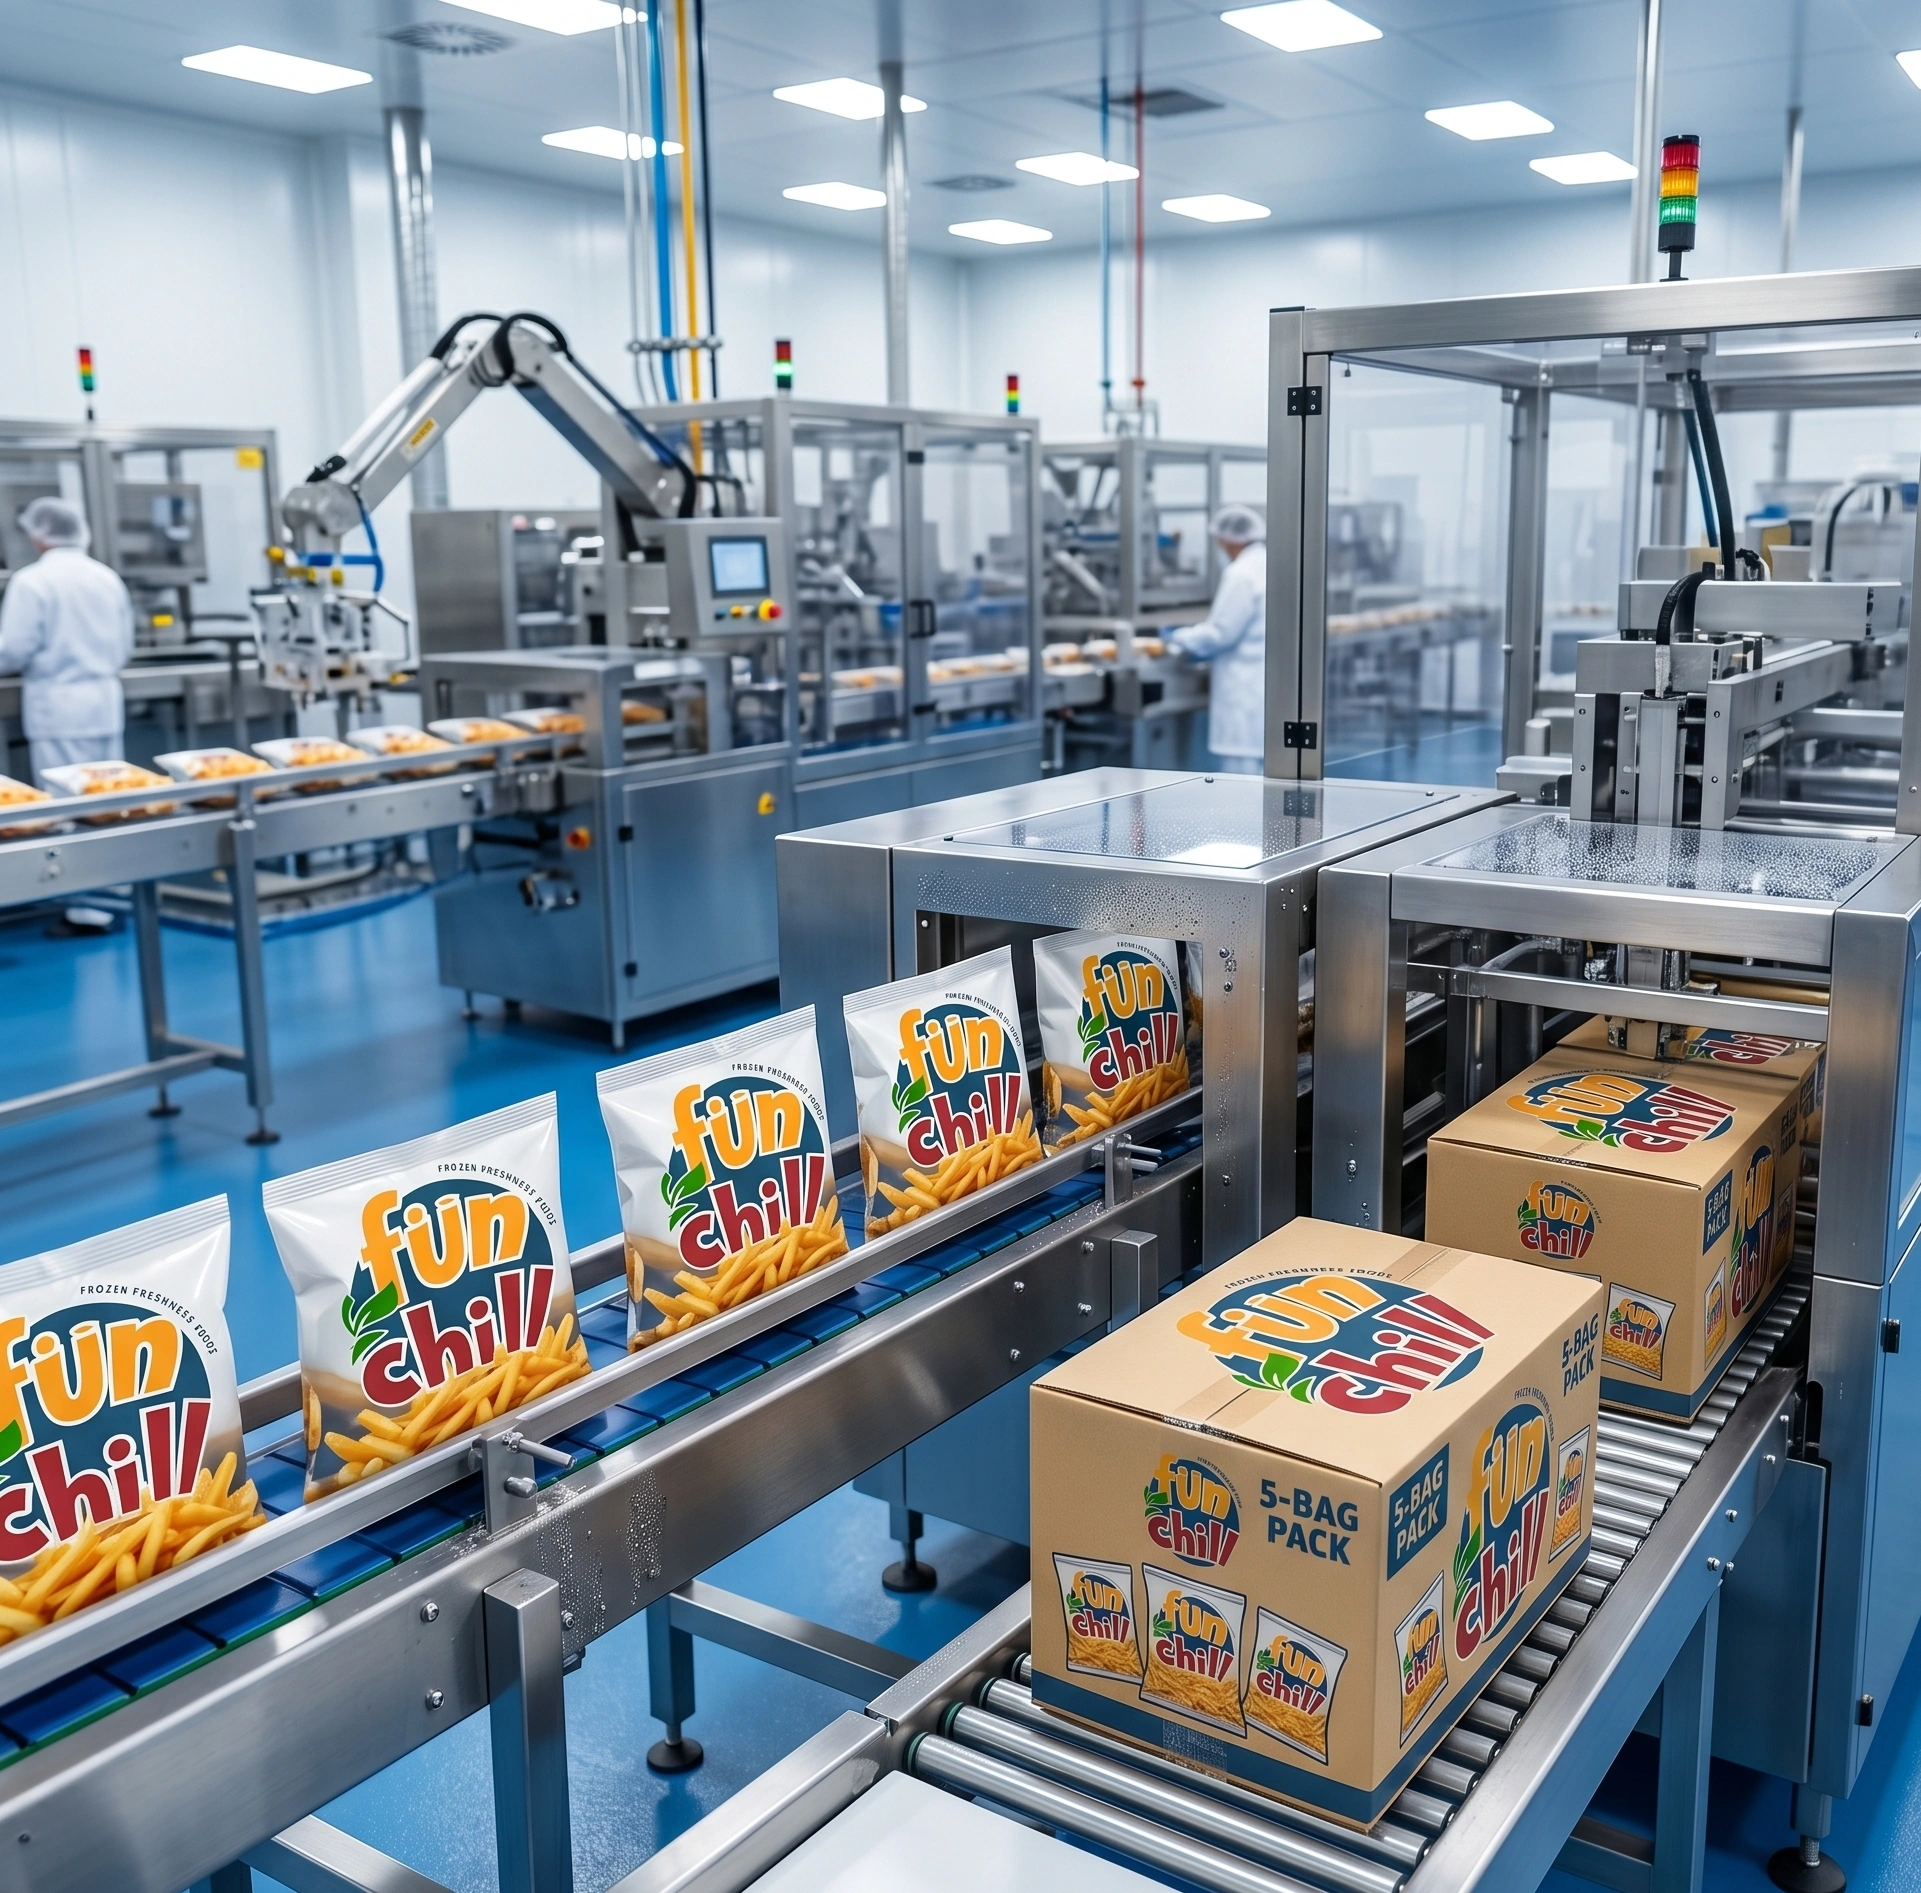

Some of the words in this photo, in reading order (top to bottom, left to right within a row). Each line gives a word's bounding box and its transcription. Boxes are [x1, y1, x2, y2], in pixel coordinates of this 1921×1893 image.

[1089, 1012, 1179, 1091] chill
[906, 1072, 1022, 1168] chill
[1611, 1084, 1738, 1153] chill
[437, 1163, 477, 1173] FROZEN
[678, 1153, 825, 1270] chill
[1520, 1220, 1594, 1259] chill
[80, 1284, 128, 1295] FROZEN
[132, 1287, 195, 1324] FRESHNESS
[194, 1324, 218, 1355] FOODS
[361, 1265, 554, 1407] chill
[1562, 1313, 1599, 1369] 5-BAG
[1609, 1322, 1660, 1349] chill
[1618, 1298, 1659, 1330] fun
[1308, 1293, 1496, 1414] chill
[1564, 1344, 1595, 1398] PACK
[0, 1398, 212, 1564] chill
[1260, 1478, 1359, 1532] 5-BAG
[1394, 1458, 1444, 1528] 5-BAG
[1147, 1508, 1239, 1567] chill
[1267, 1514, 1351, 1566] PACK
[1396, 1493, 1441, 1560] PACK
[1073, 1570, 1123, 1612] fun
[1455, 1486, 1549, 1661] chill
[1071, 1610, 1130, 1644] chill
[1155, 1635, 1234, 1682] chill
[1270, 1634, 1326, 1687] fun
[1405, 1632, 1440, 1695] chill
[1256, 1669, 1326, 1716] chill
